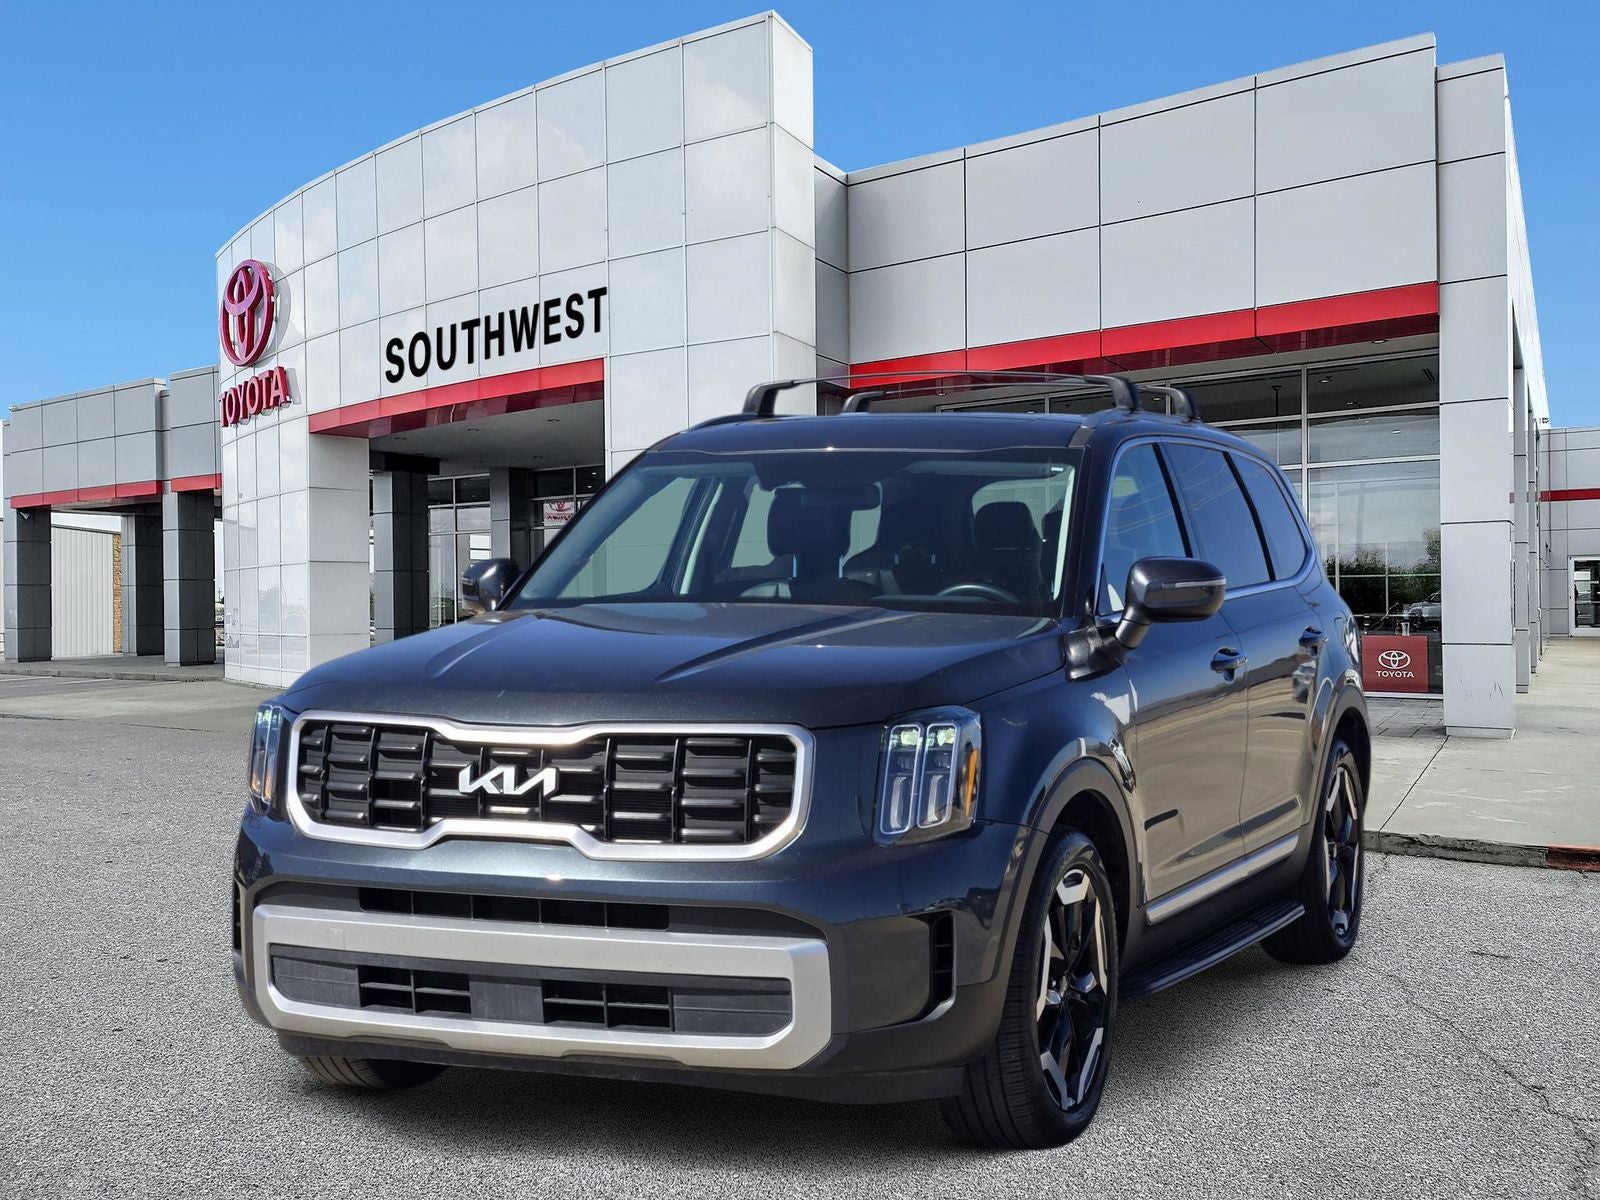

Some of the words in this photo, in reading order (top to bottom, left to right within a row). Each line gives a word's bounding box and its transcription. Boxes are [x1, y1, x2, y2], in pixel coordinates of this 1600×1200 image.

[385, 286, 608, 383] SOUTHWEST
[218, 366, 290, 428] TOYOTA
[1376, 670, 1414, 678] TOYOTA
